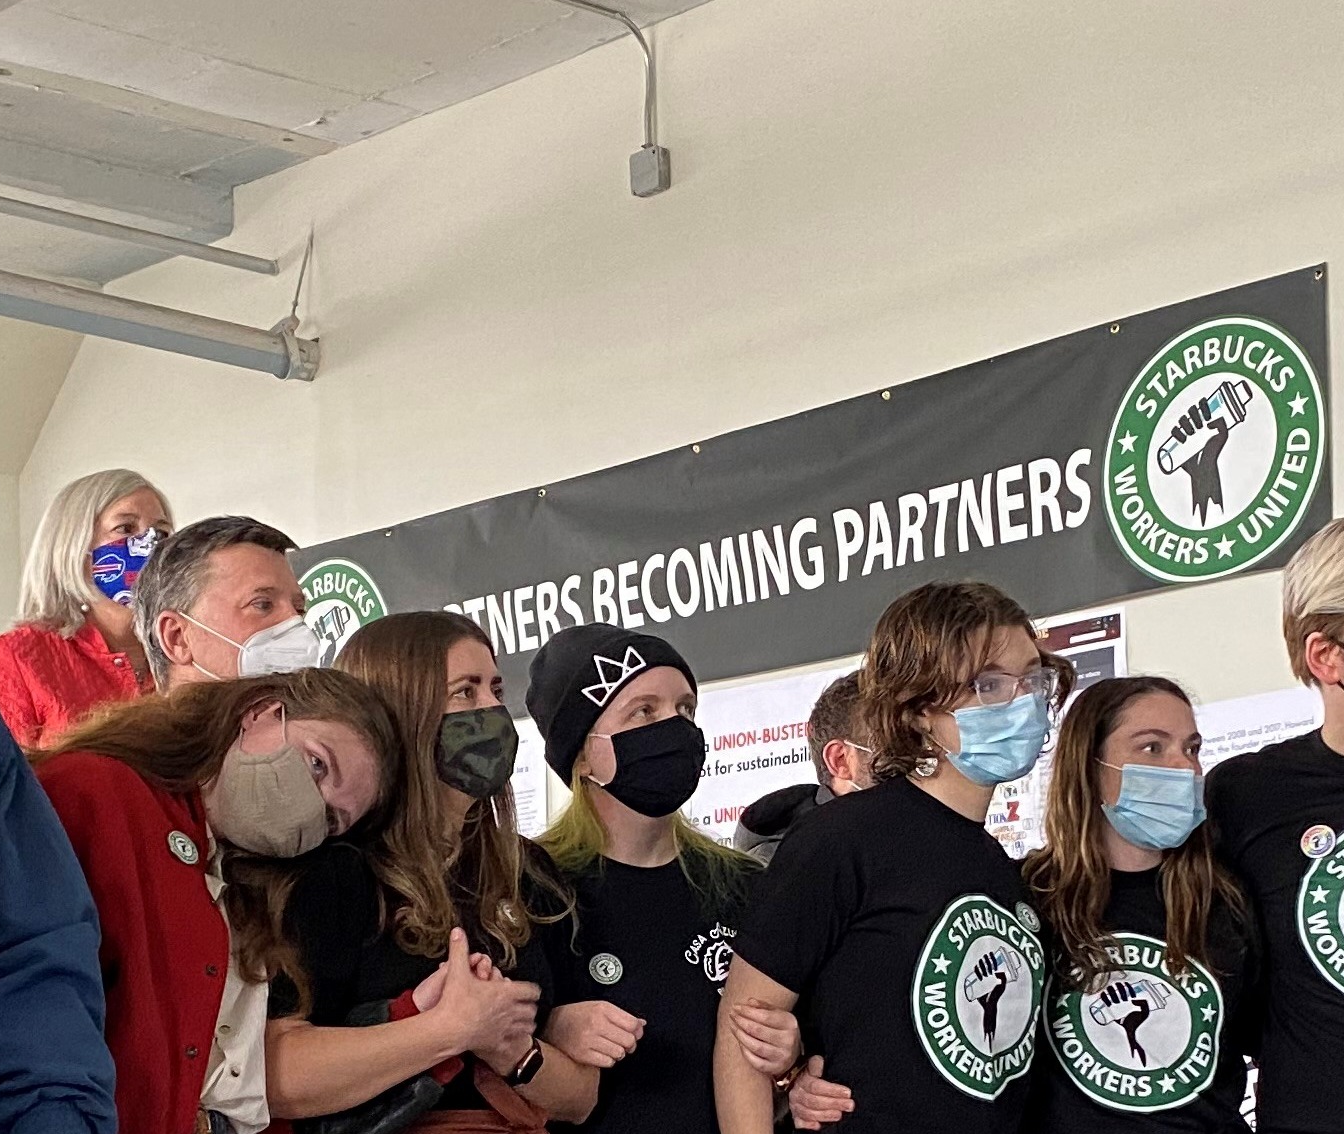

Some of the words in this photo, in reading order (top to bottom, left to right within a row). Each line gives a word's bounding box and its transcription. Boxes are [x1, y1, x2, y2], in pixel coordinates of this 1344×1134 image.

[1135, 335, 1296, 419] STARBUCKS
[1114, 463, 1210, 565] WORKERS
[1237, 427, 1311, 545] UNITED
[443, 574, 585, 657] TNERS
[593, 517, 825, 630] BECOMING
[832, 448, 1093, 583] PARTNERS
[699, 765, 712, 777] ot
[715, 759, 734, 777] for
[684, 934, 708, 965] CASA
[948, 908, 1043, 971] STARBUCKS
[924, 980, 994, 1084] WORKERS
[993, 1005, 1041, 1078] UNIT
[1052, 1013, 1153, 1097] WORKERS
[1172, 1031, 1213, 1085] ITED
